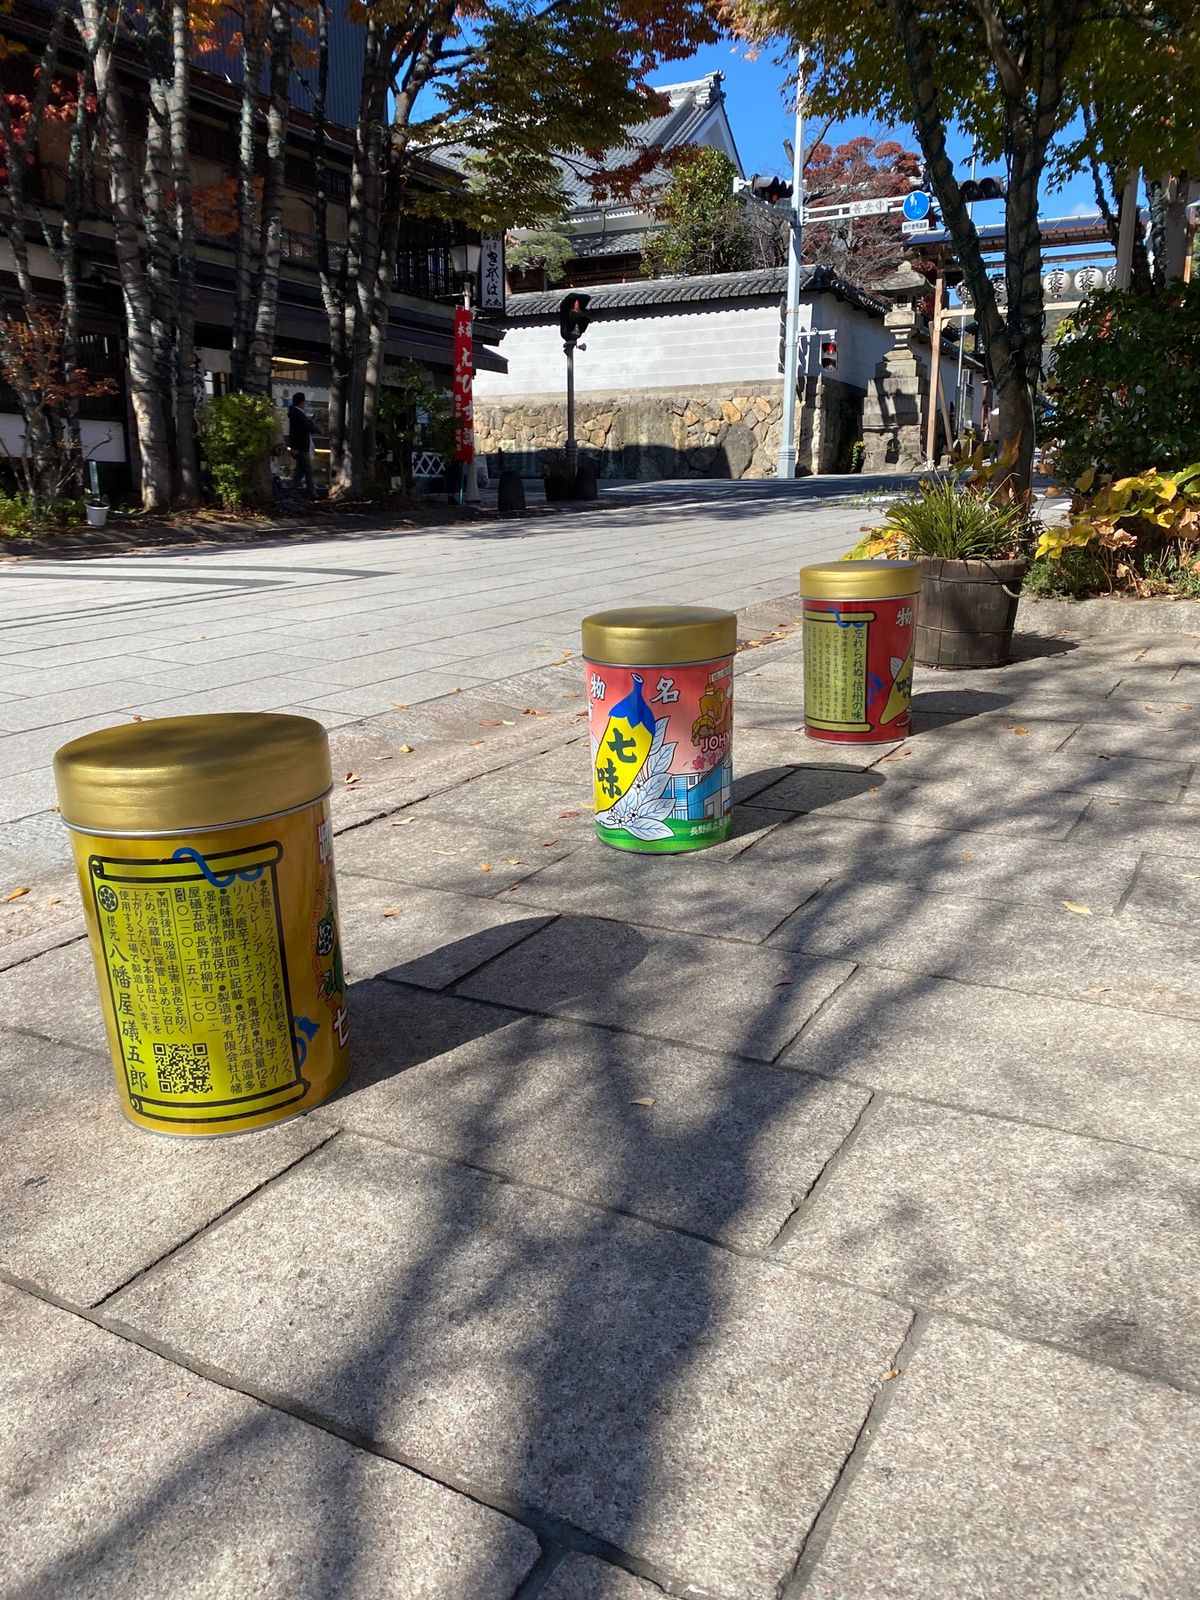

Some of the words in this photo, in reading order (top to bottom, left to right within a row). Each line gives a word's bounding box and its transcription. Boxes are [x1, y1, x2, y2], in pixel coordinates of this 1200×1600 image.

[853, 200, 885, 214] 善光寺
[650, 676, 680, 703] 名
[596, 728, 637, 799] 七味
